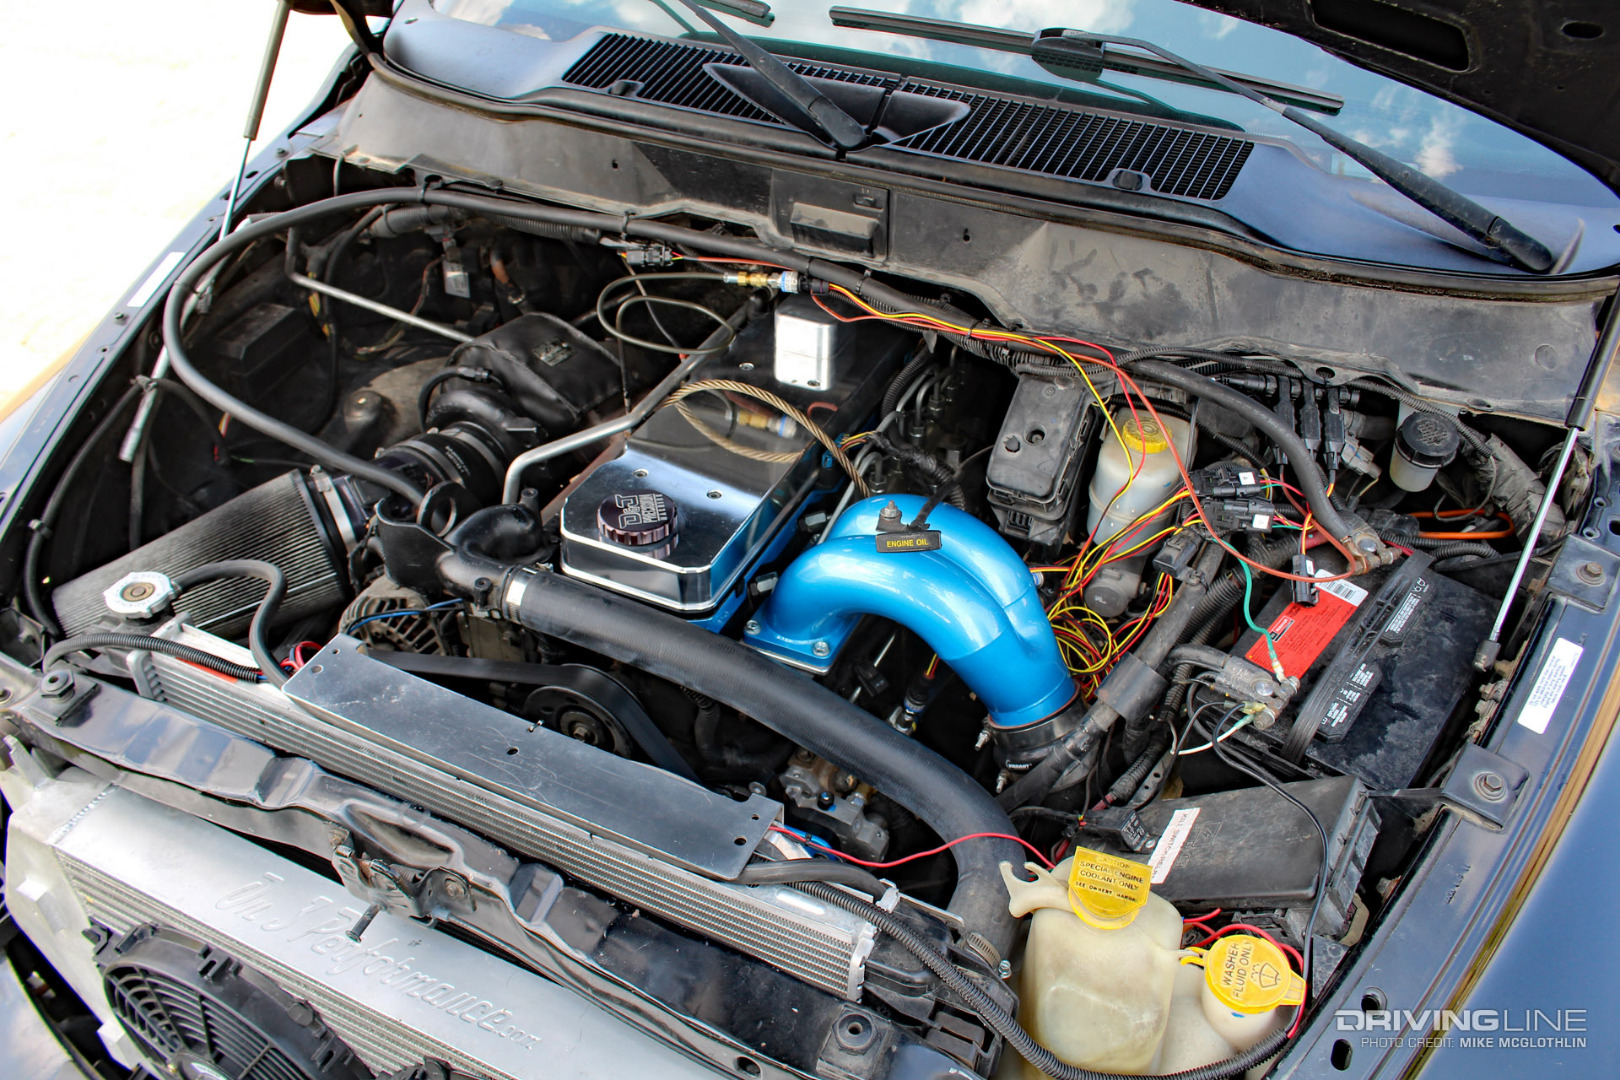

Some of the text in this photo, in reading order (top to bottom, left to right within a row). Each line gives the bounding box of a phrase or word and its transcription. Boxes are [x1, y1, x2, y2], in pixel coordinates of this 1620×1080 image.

[886, 538, 929, 548] ENGINE OIL
[1080, 861, 1144, 884] SPECIAL ENGINE
[1080, 870, 1138, 891] COOLANT ONLY
[1223, 943, 1239, 986] WASHER
[1233, 940, 1252, 998] FLUID ONLY
